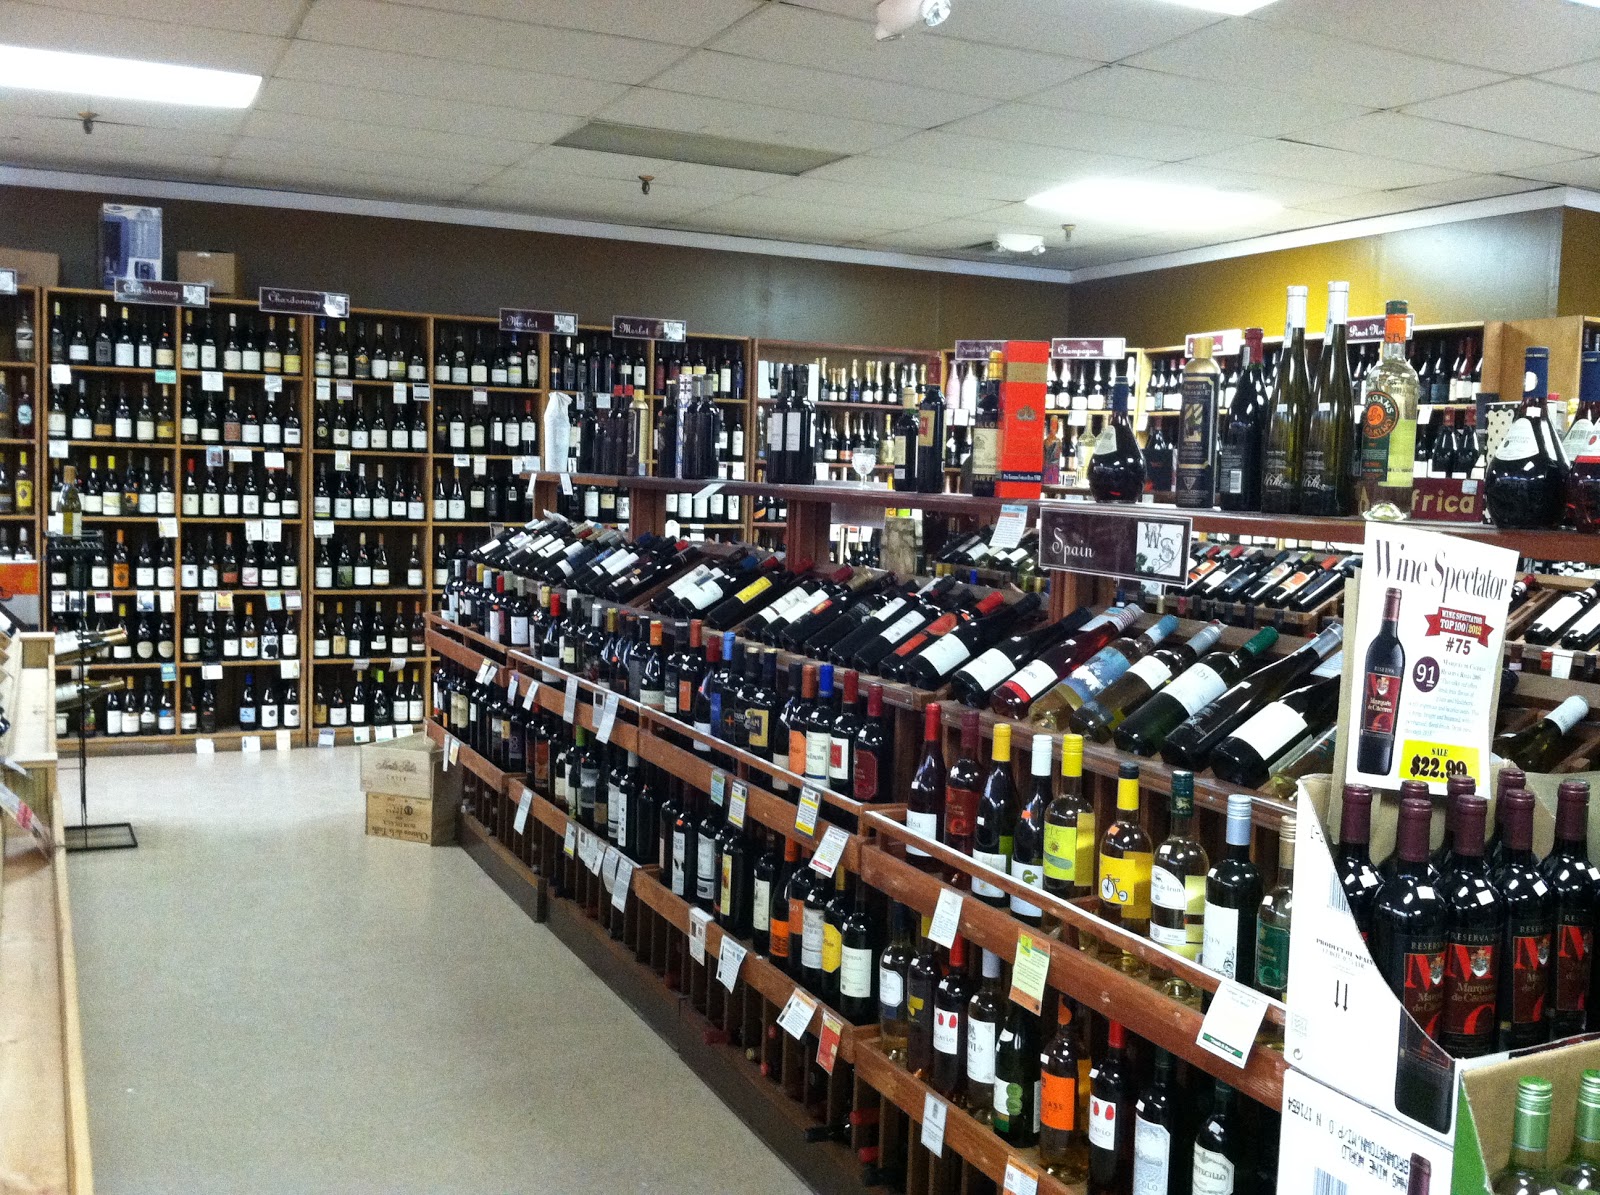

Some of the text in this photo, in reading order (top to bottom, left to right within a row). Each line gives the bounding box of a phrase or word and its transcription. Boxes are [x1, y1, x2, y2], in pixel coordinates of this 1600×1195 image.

[123, 280, 179, 298] Chardonnay
[267, 290, 321, 308] Chardonnay
[506, 315, 538, 329] Merlot
[619, 322, 649, 336] Merlot
[1349, 323, 1386, 337] Pinot Noi
[1058, 344, 1099, 357] Champagne
[1052, 527, 1095, 565] Spain
[1375, 539, 1508, 603] Wine Spectator
[1440, 619, 1455, 629] TOP
[1441, 609, 1483, 624] WINE SPECTATOR
[1445, 636, 1471, 655] #75
[1416, 663, 1435, 685] 91
[1431, 747, 1449, 758] SALE
[1410, 754, 1467, 780] $22.99
[1450, 932, 1489, 942] RESERVA
[1316, 938, 1344, 953] PRODUCT
[1355, 954, 1373, 965] SPAIN
